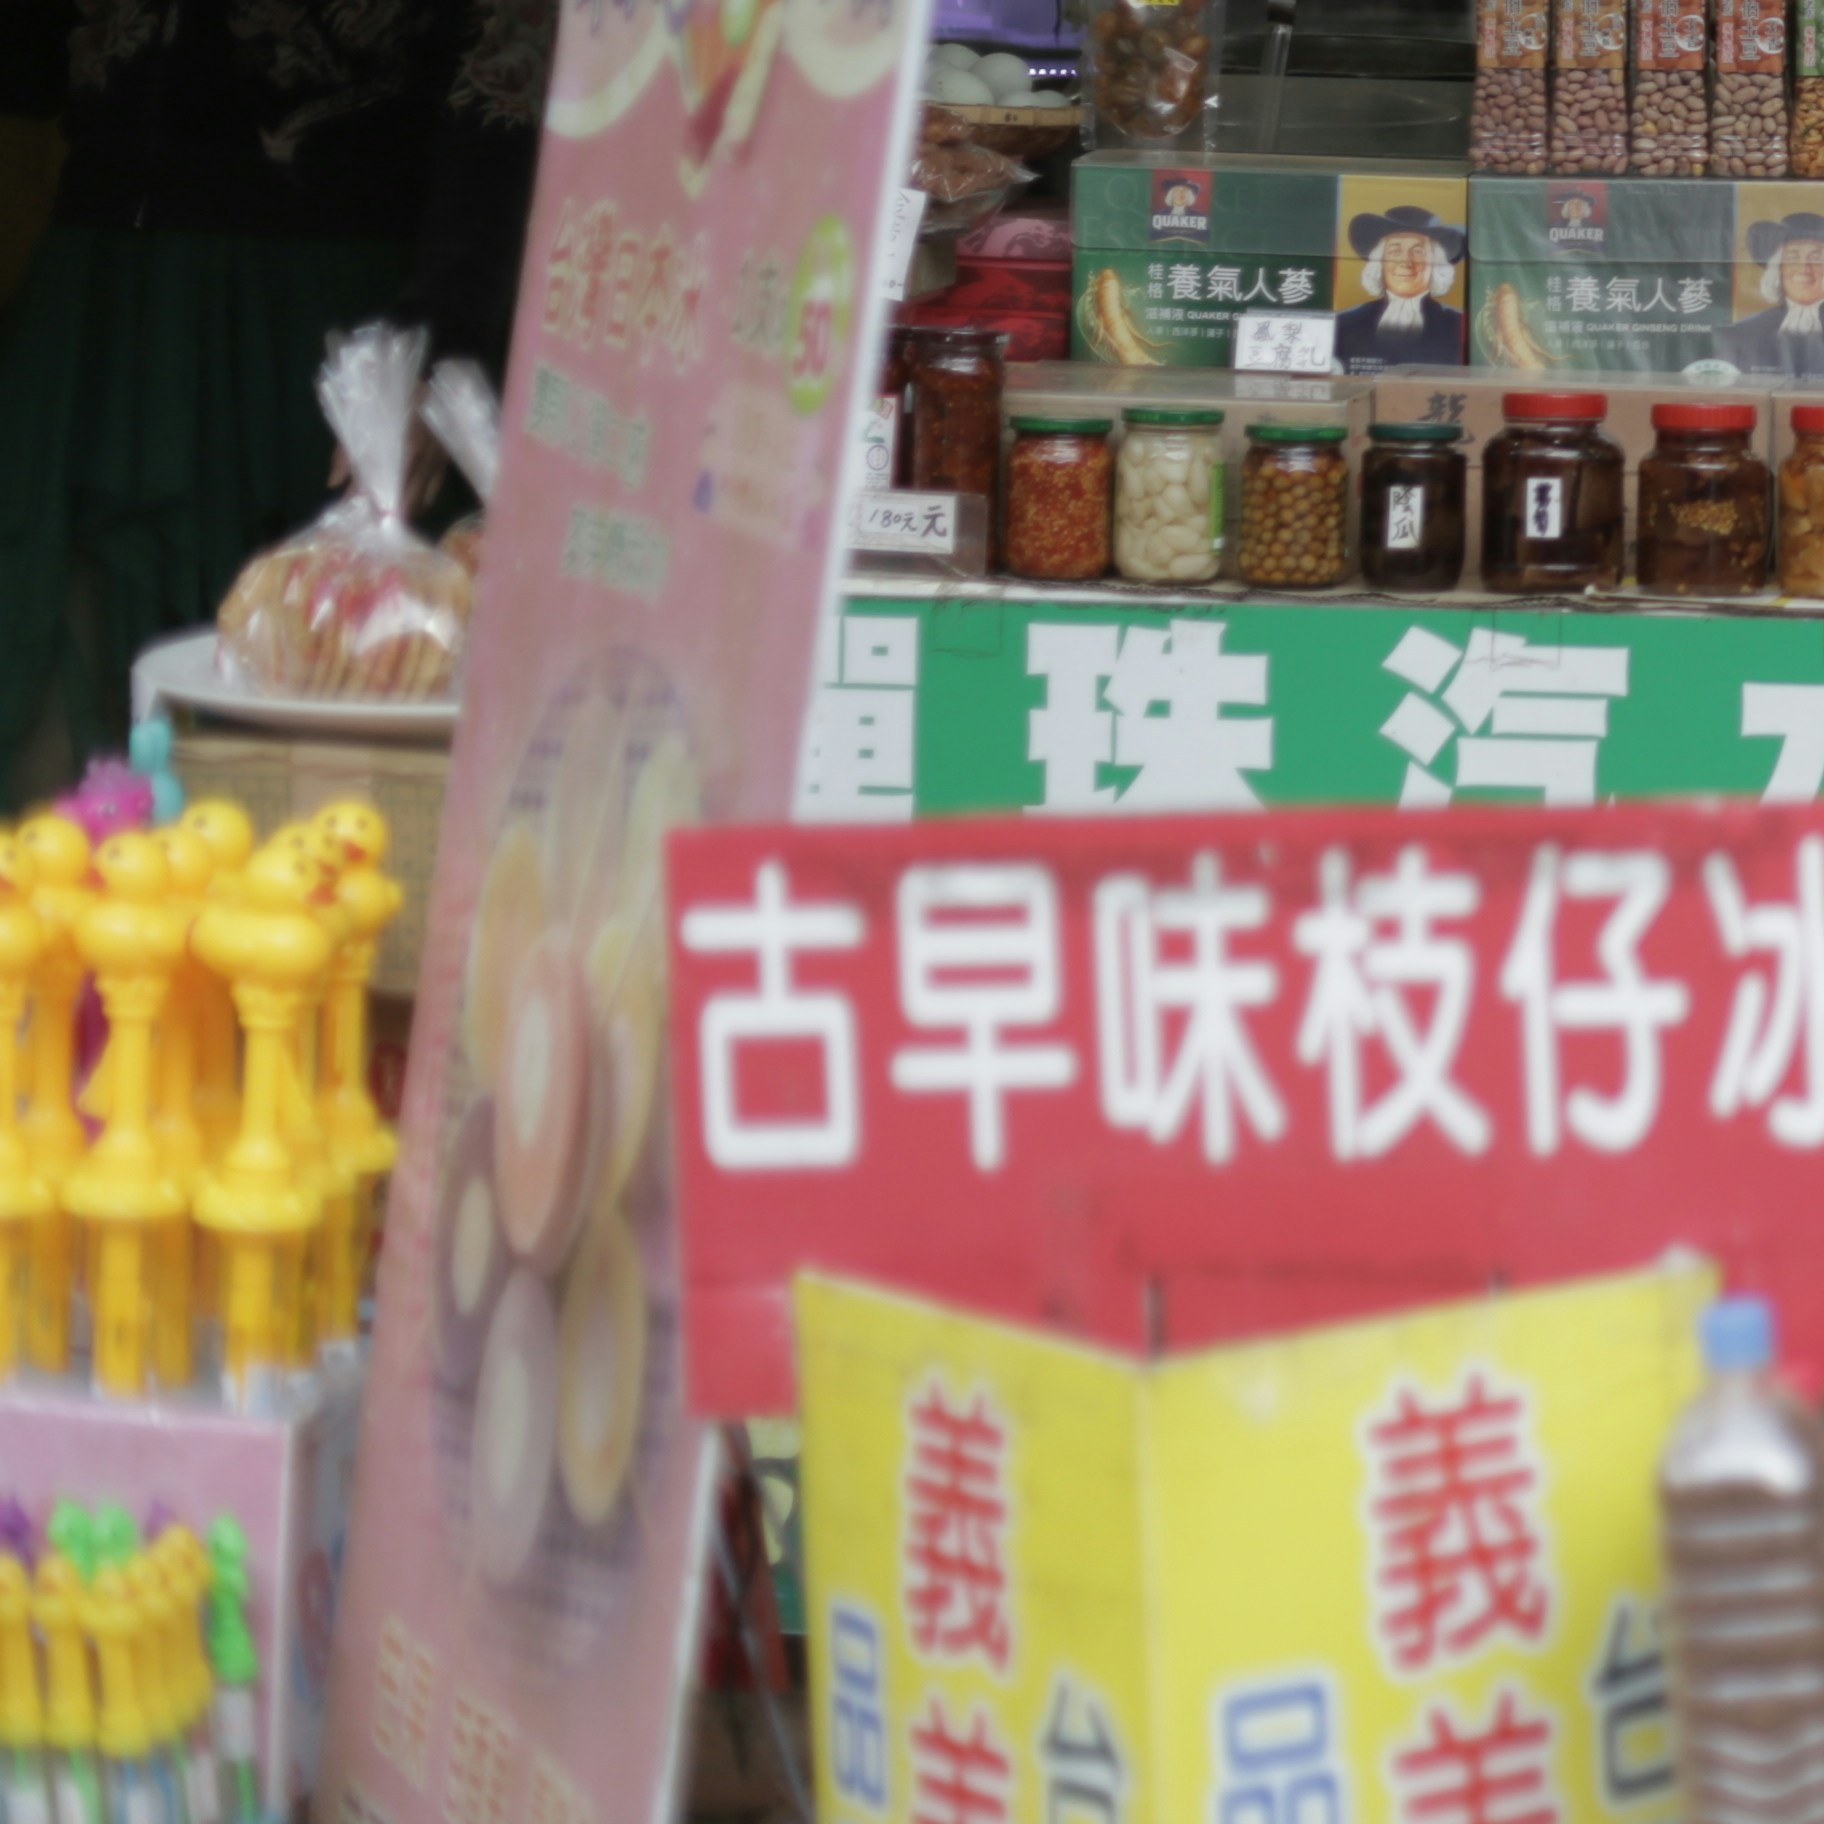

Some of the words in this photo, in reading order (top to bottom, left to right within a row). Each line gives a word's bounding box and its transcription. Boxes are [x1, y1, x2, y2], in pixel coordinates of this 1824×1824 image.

[1152, 214, 1208, 231] QUAKER
[1548, 226, 1605, 243] QUAKER
[1187, 310, 1230, 321] QUAKER
